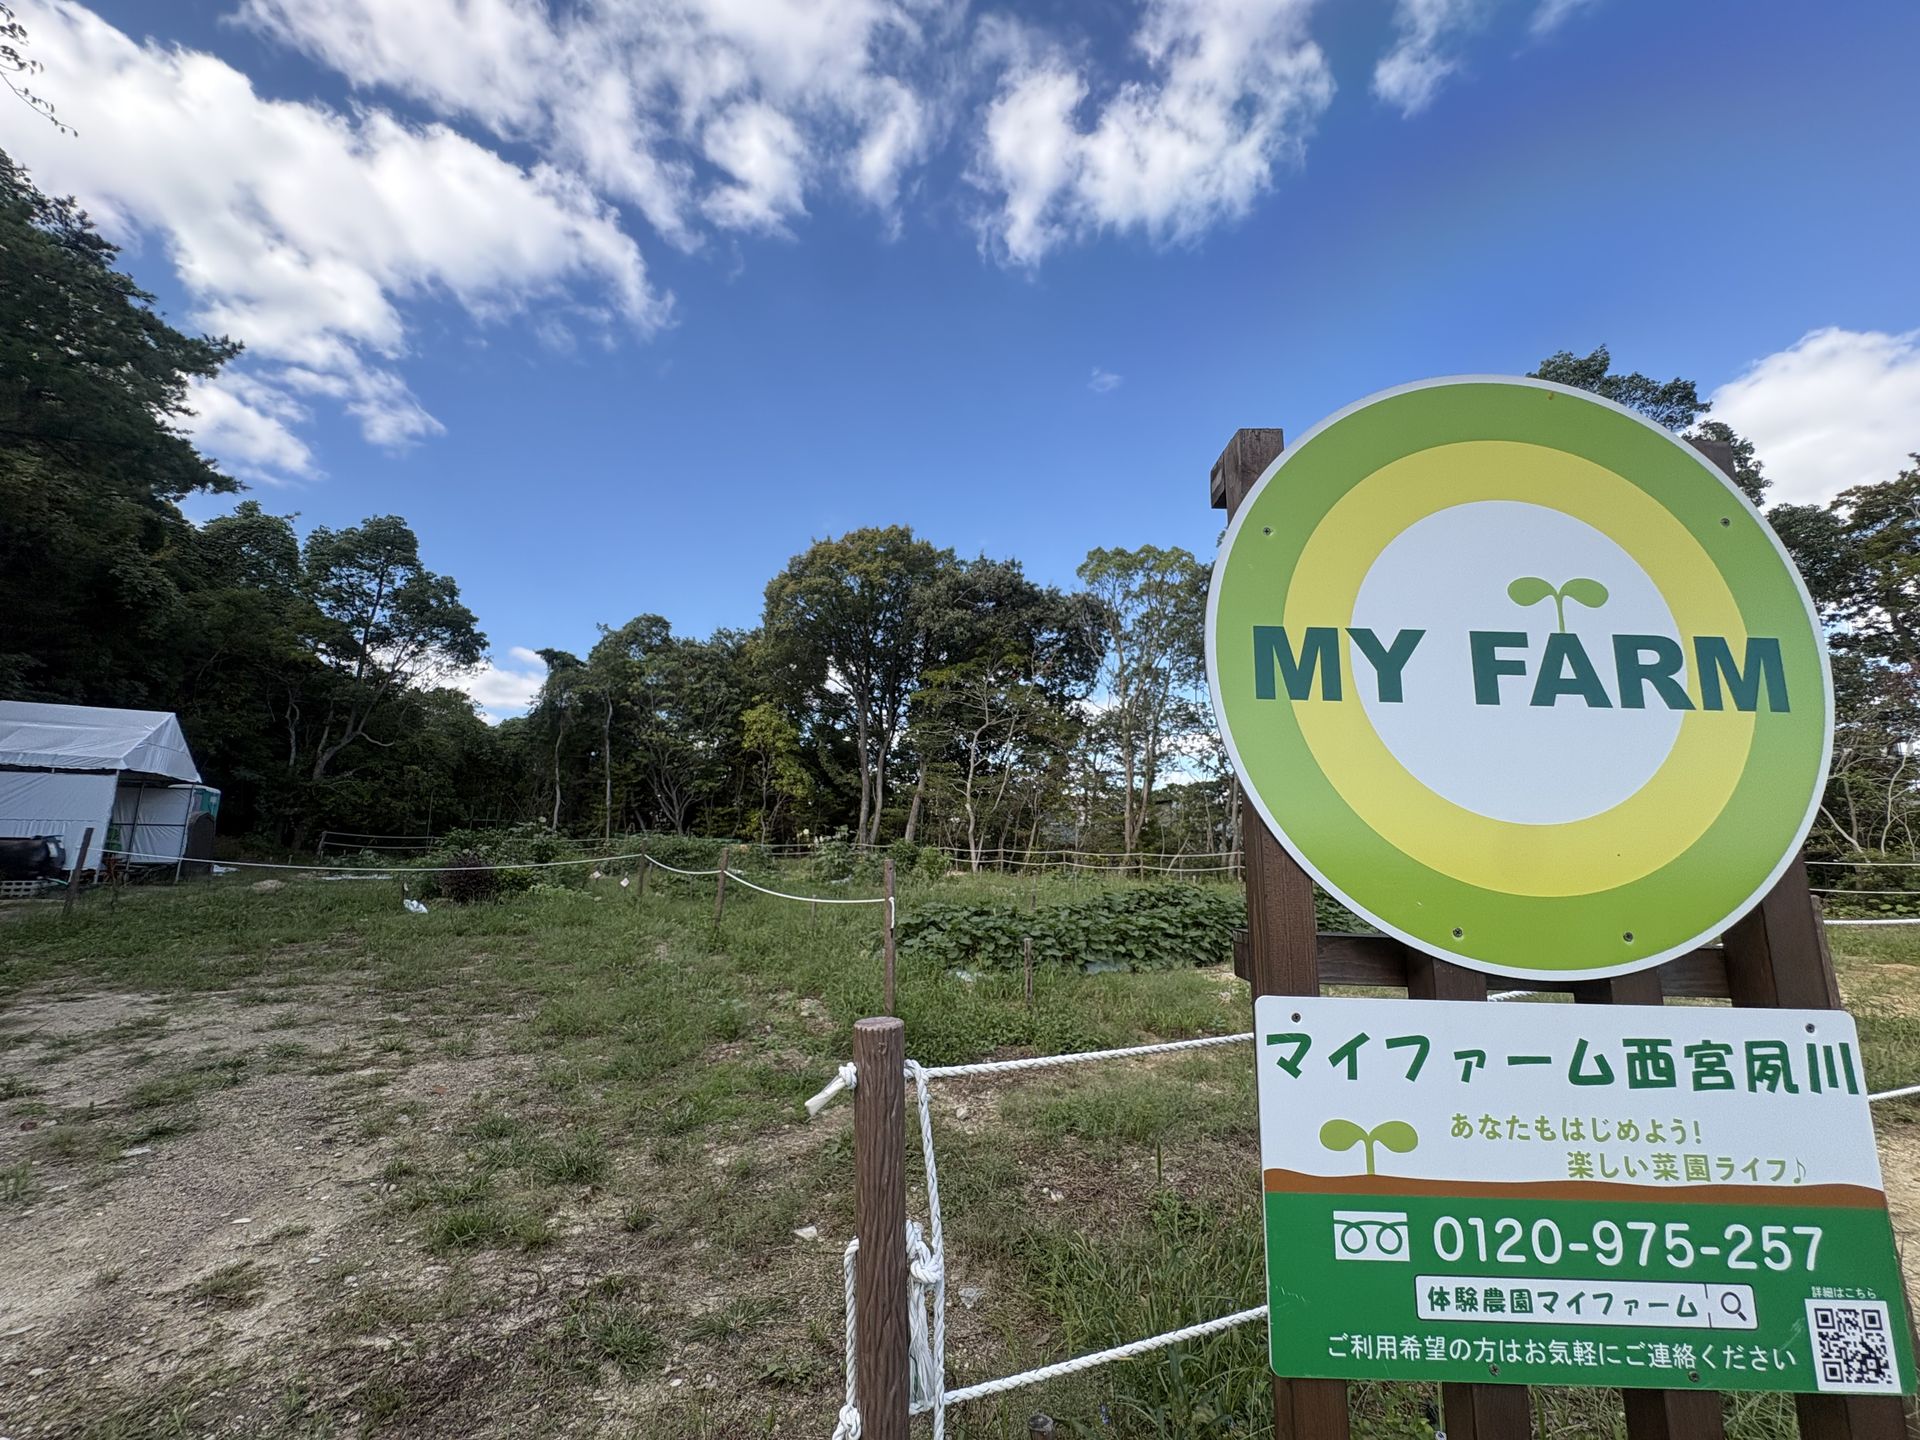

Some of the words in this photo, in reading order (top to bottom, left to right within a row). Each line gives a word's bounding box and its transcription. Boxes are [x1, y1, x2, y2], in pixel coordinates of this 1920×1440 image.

[1252, 625, 1426, 703] MY
[1469, 631, 1790, 713] FARM
[1265, 1031, 1860, 1096] マイファーム西宮夙川
[1432, 1215, 1824, 1271] 0120-975-257
[1427, 1285, 1699, 1319] 体験農園マイファーム
[1811, 1285, 1877, 1300] 詳細はこちら
[1327, 1334, 1797, 1373] ご利用希望の方はお気軽にご連絡ください
